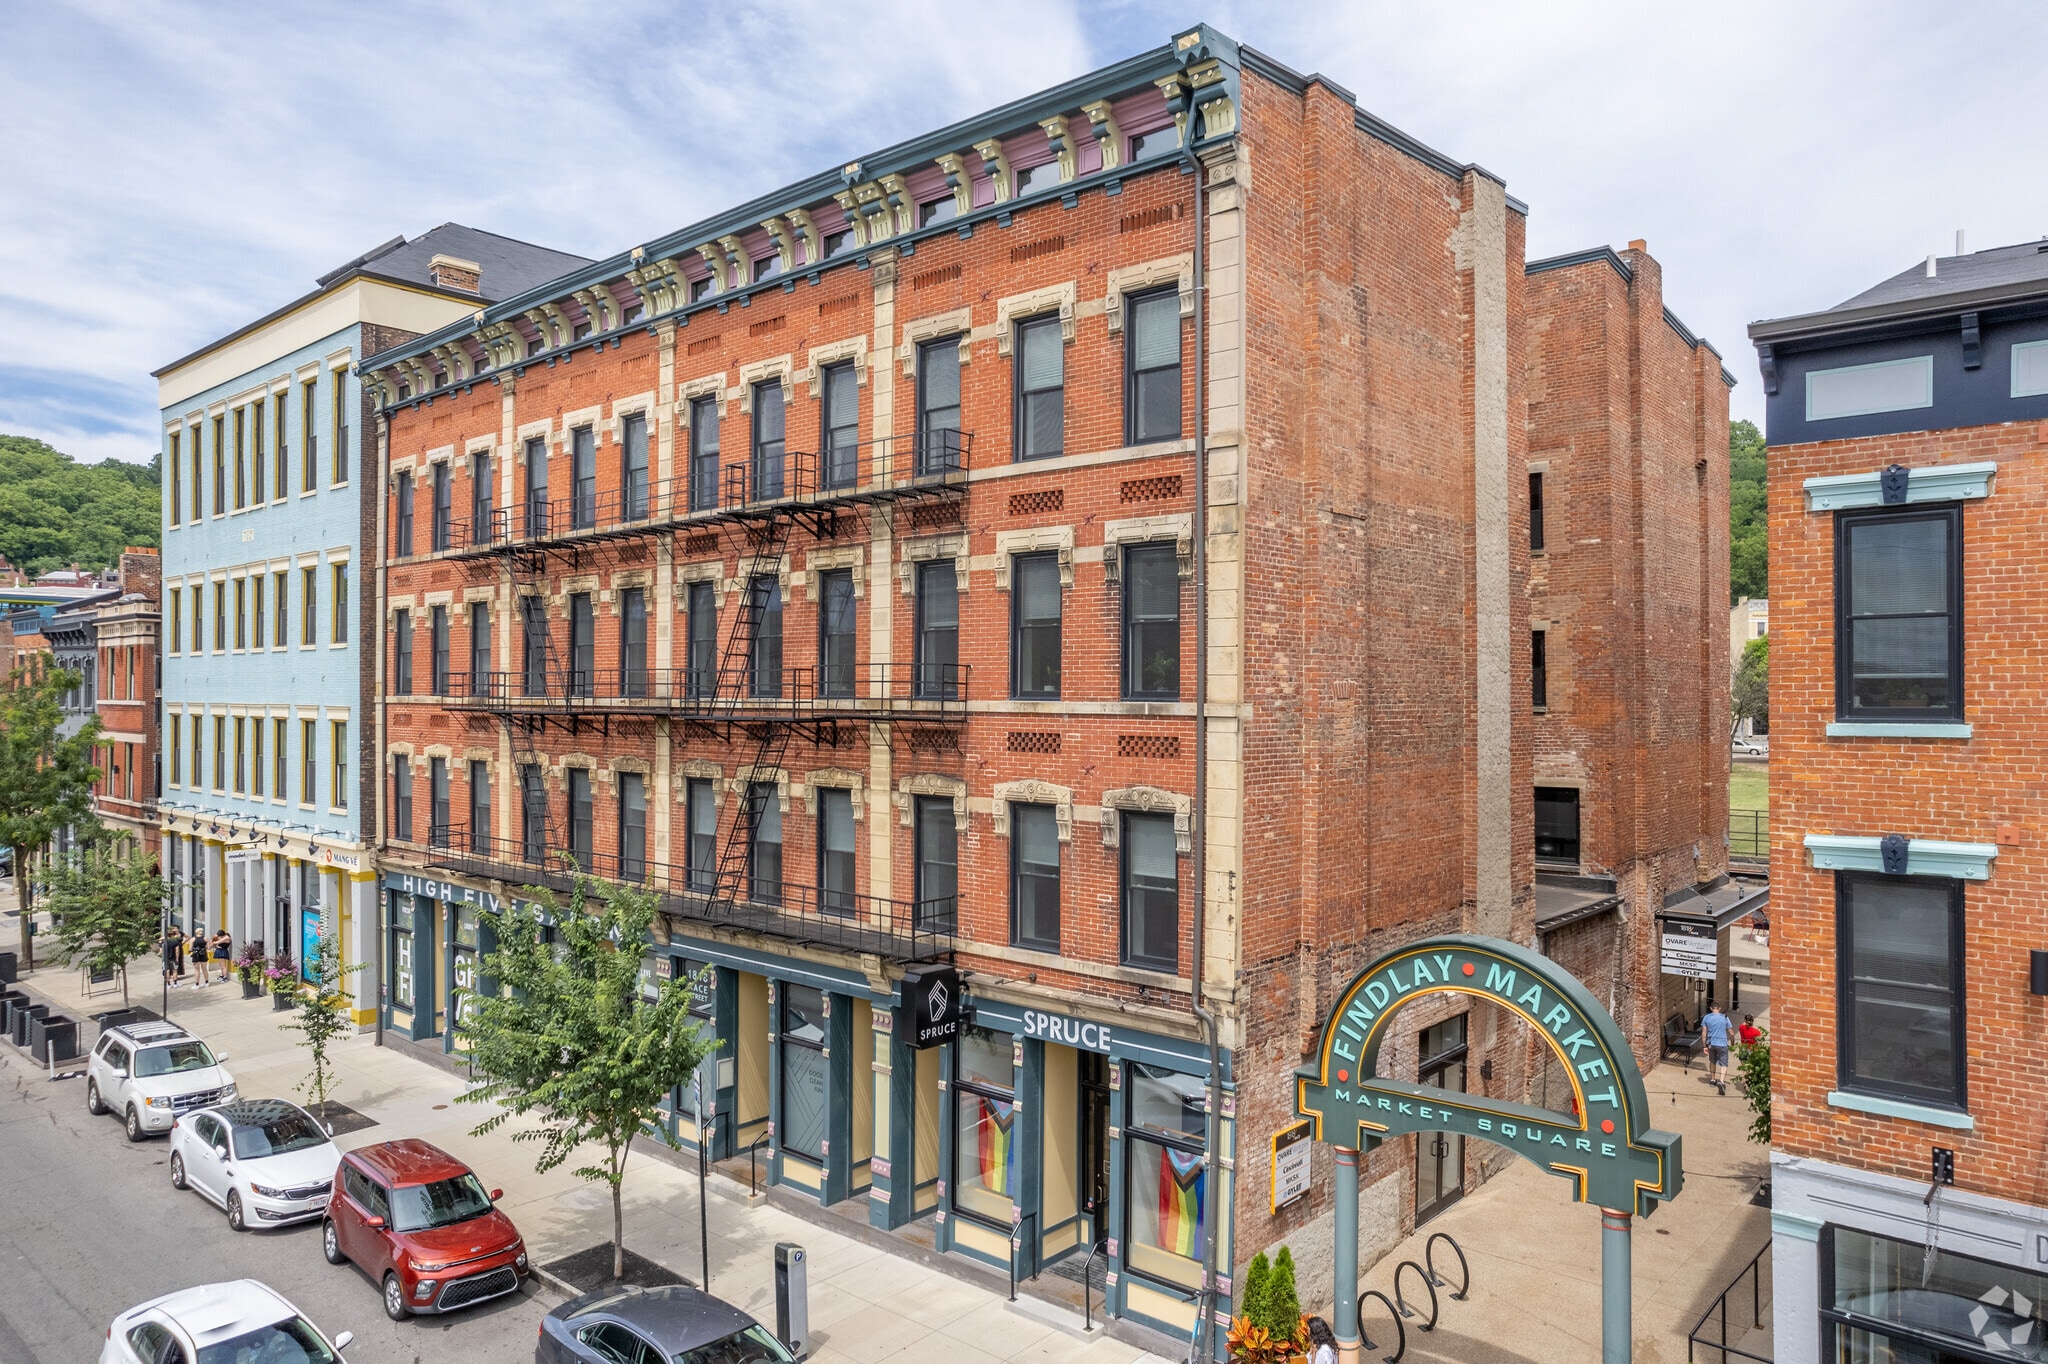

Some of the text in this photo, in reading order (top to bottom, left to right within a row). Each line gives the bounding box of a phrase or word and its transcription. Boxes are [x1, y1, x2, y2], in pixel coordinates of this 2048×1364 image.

[403, 874, 452, 900] HIGH
[689, 984, 709, 995] ACE
[690, 992, 708, 1003] TREET
[920, 1022, 956, 1041] SPRUCE
[1023, 1010, 1111, 1051] SPRUCE
[1333, 954, 1619, 1109] FINDLAY MARKET
[1335, 1088, 1617, 1157] MARKET SQUARE
